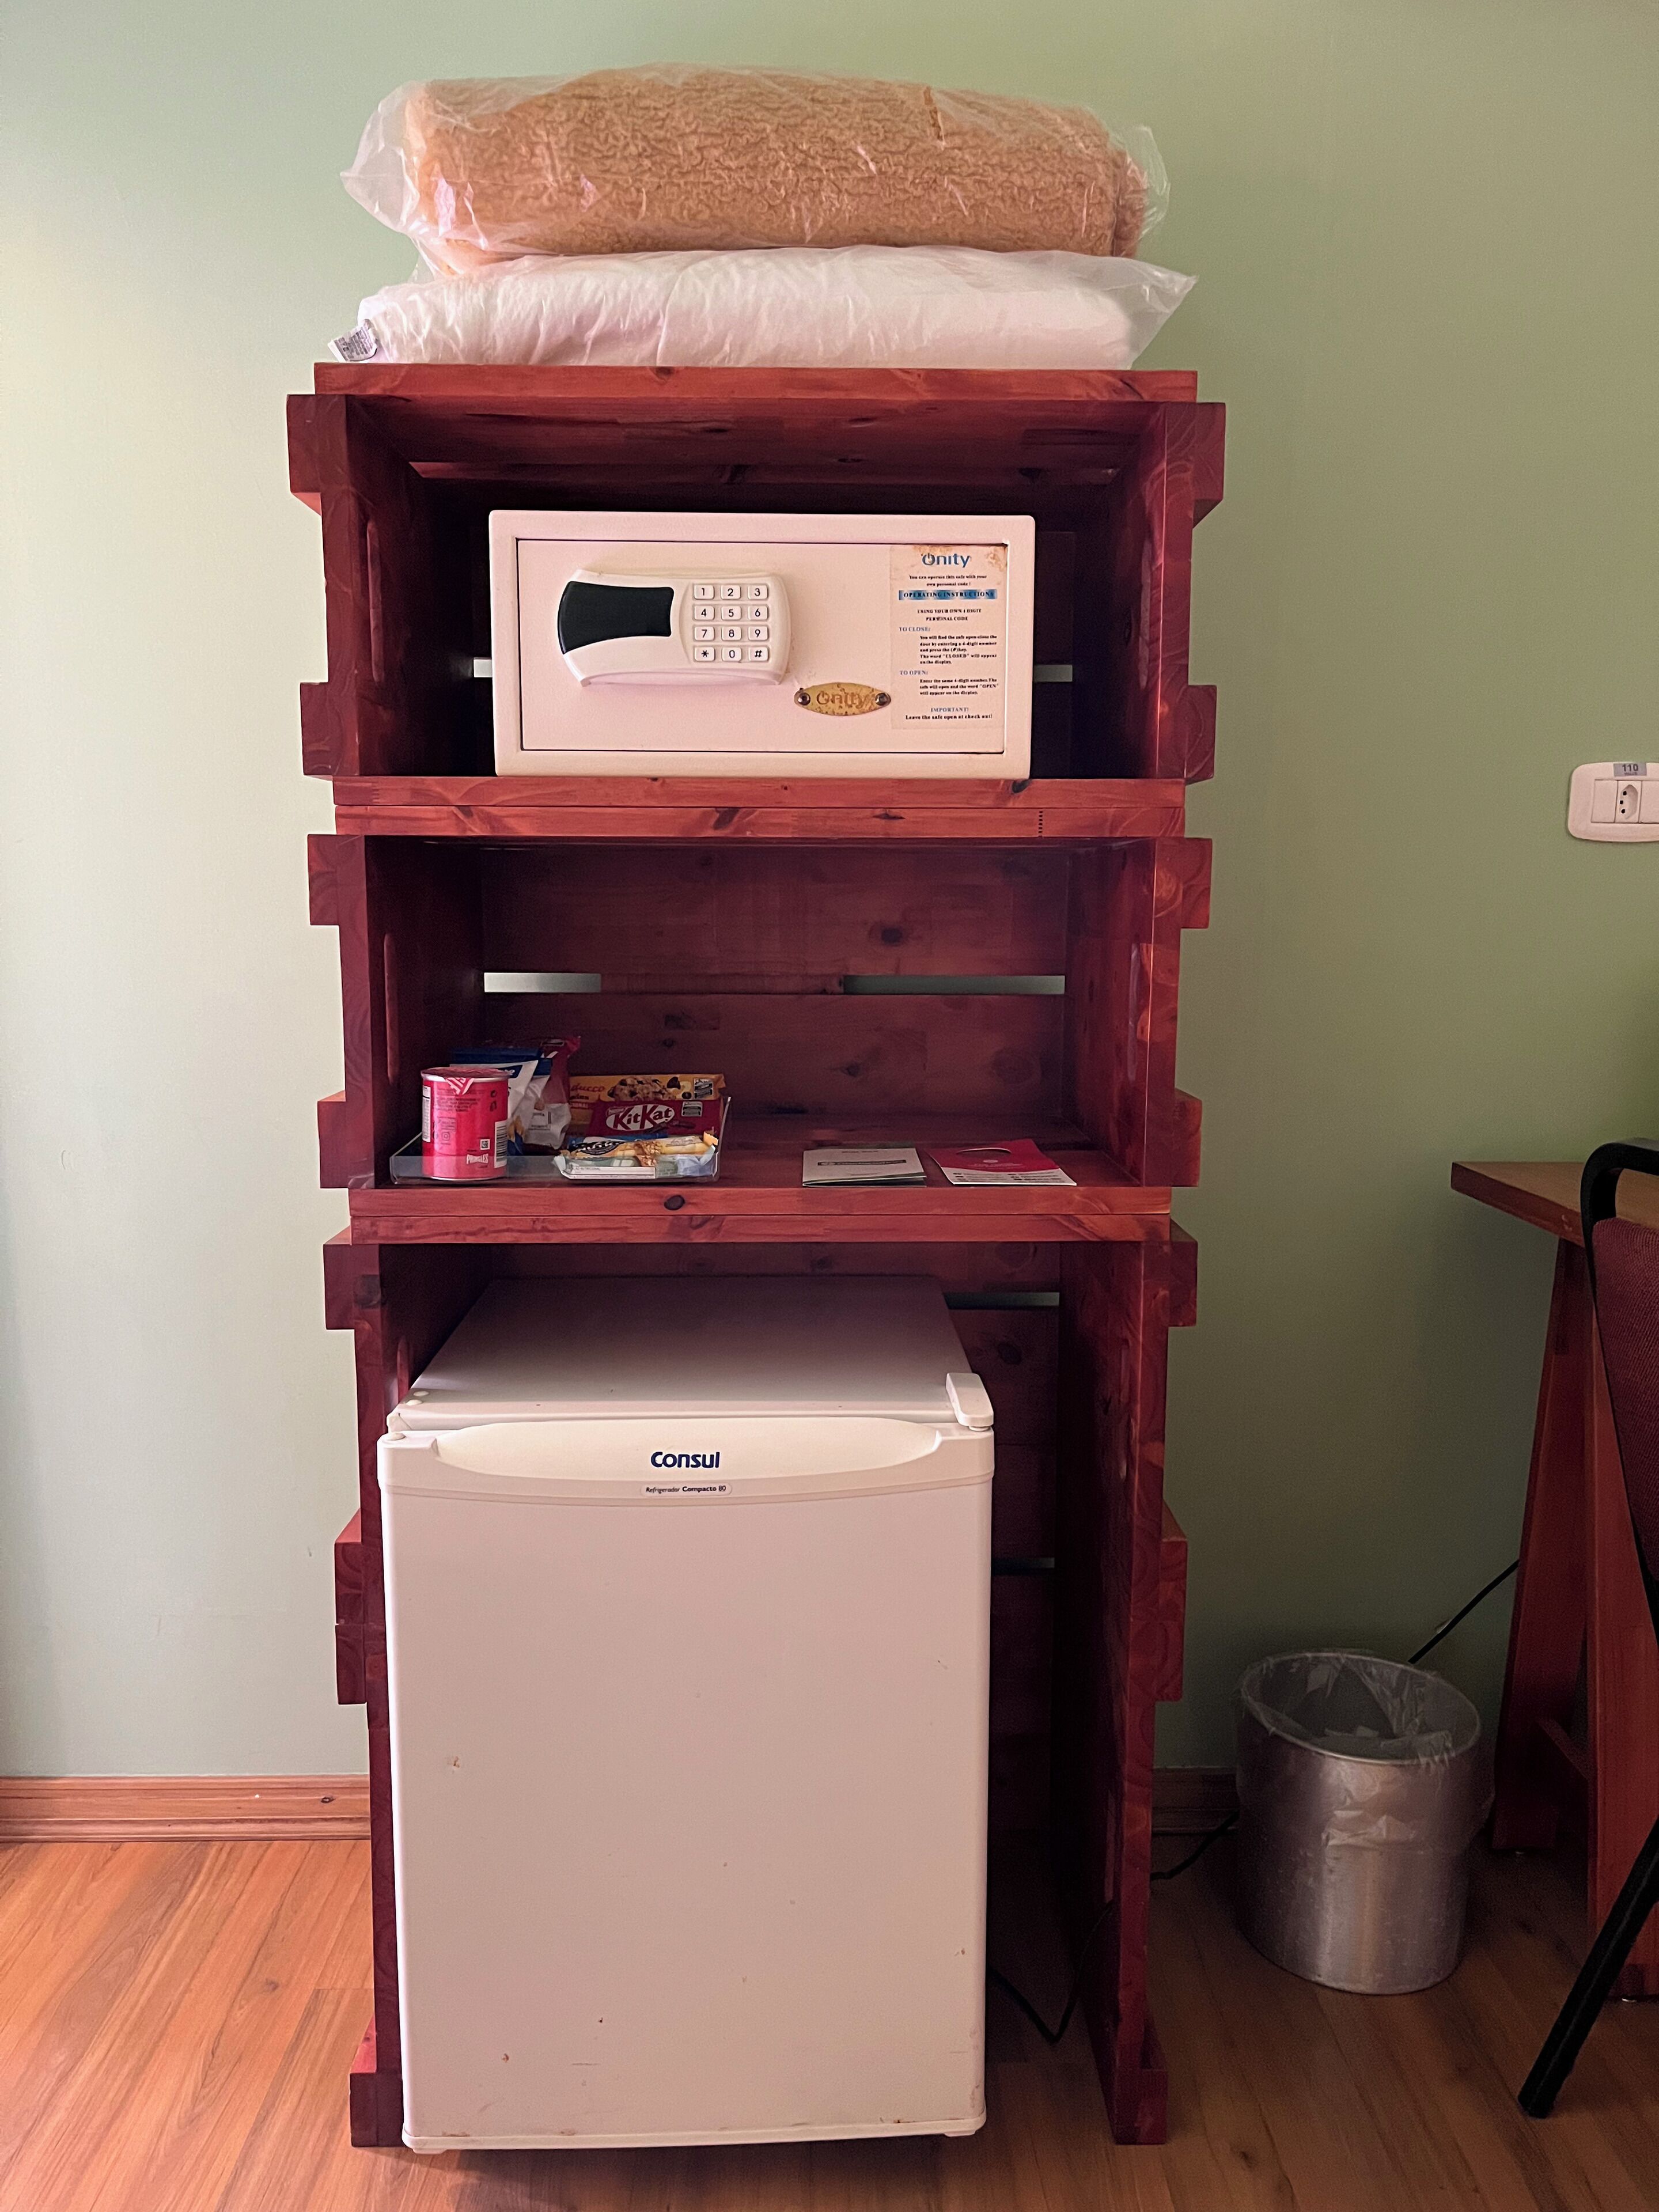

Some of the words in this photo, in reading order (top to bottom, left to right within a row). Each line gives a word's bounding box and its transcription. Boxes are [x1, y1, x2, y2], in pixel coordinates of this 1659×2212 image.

[922, 553, 971, 568] Onity
[701, 588, 705, 596] 1
[727, 588, 734, 597] 2
[754, 588, 760, 597] 3
[701, 608, 707, 617] 4
[728, 609, 734, 618] 5
[755, 608, 761, 617] 6
[701, 629, 707, 638] 7
[729, 629, 734, 638] 8
[755, 629, 761, 638] 9
[1622, 763, 1638, 772] 110
[612, 1105, 672, 1130] KitKat
[467, 1153, 489, 1164] PRINGLES
[650, 1451, 721, 1468] Consul
[645, 1486, 680, 1494] Refrigerador
